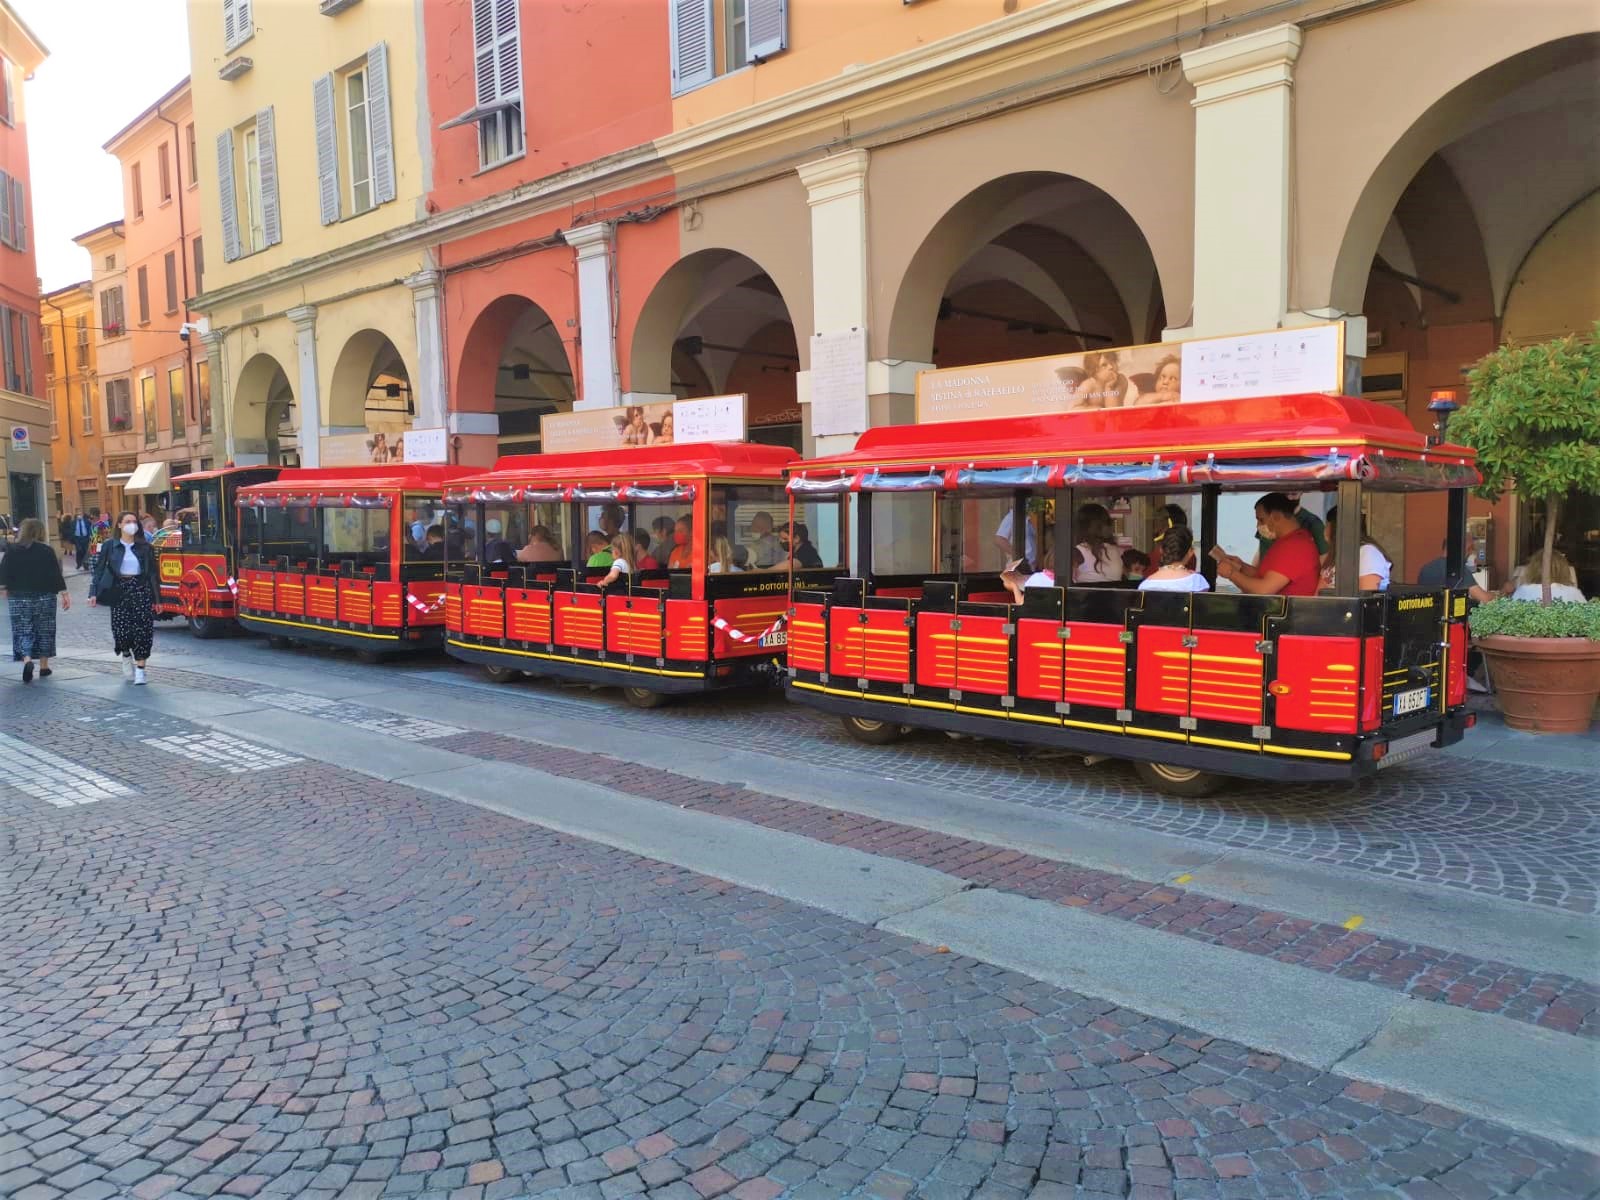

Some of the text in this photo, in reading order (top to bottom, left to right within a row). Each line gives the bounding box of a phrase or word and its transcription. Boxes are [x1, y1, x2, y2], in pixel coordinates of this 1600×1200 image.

[943, 376, 991, 388] MADONNA
[1398, 597, 1434, 611] DOTTOTRAINS
[764, 631, 787, 645] XA 85
